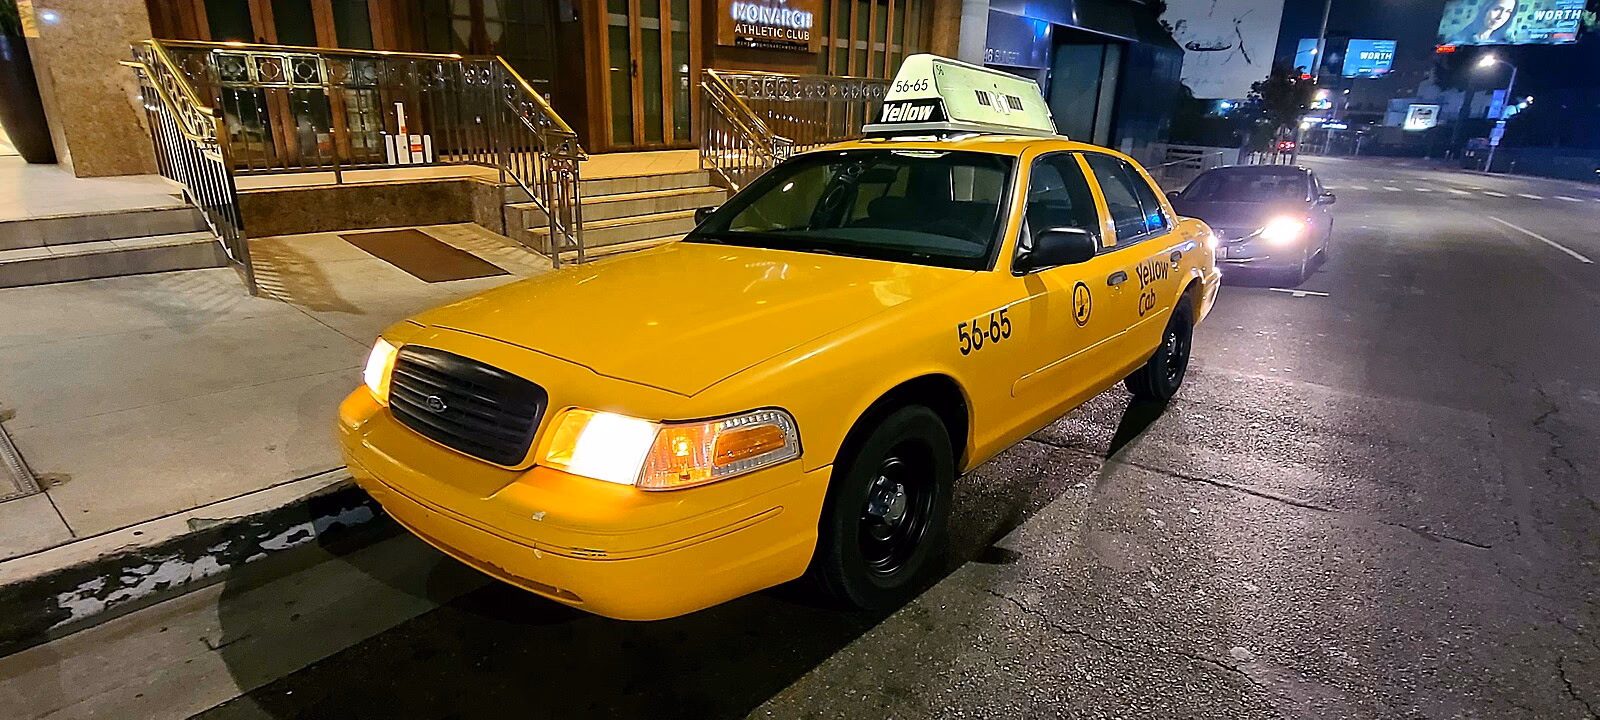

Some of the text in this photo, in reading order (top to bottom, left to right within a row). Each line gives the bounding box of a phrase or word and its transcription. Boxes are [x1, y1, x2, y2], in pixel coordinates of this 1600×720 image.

[732, 2, 812, 28] MONARCH
[1534, 9, 1581, 20] WORTH
[735, 23, 810, 40] ATHLETIC CLUB
[1360, 52, 1392, 60] WORTH
[895, 78, 929, 93] 56-65
[880, 102, 935, 123] Yellow
[1136, 257, 1169, 290] Yellow
[1138, 288, 1156, 317] Cab
[957, 308, 1012, 356] 56-65
